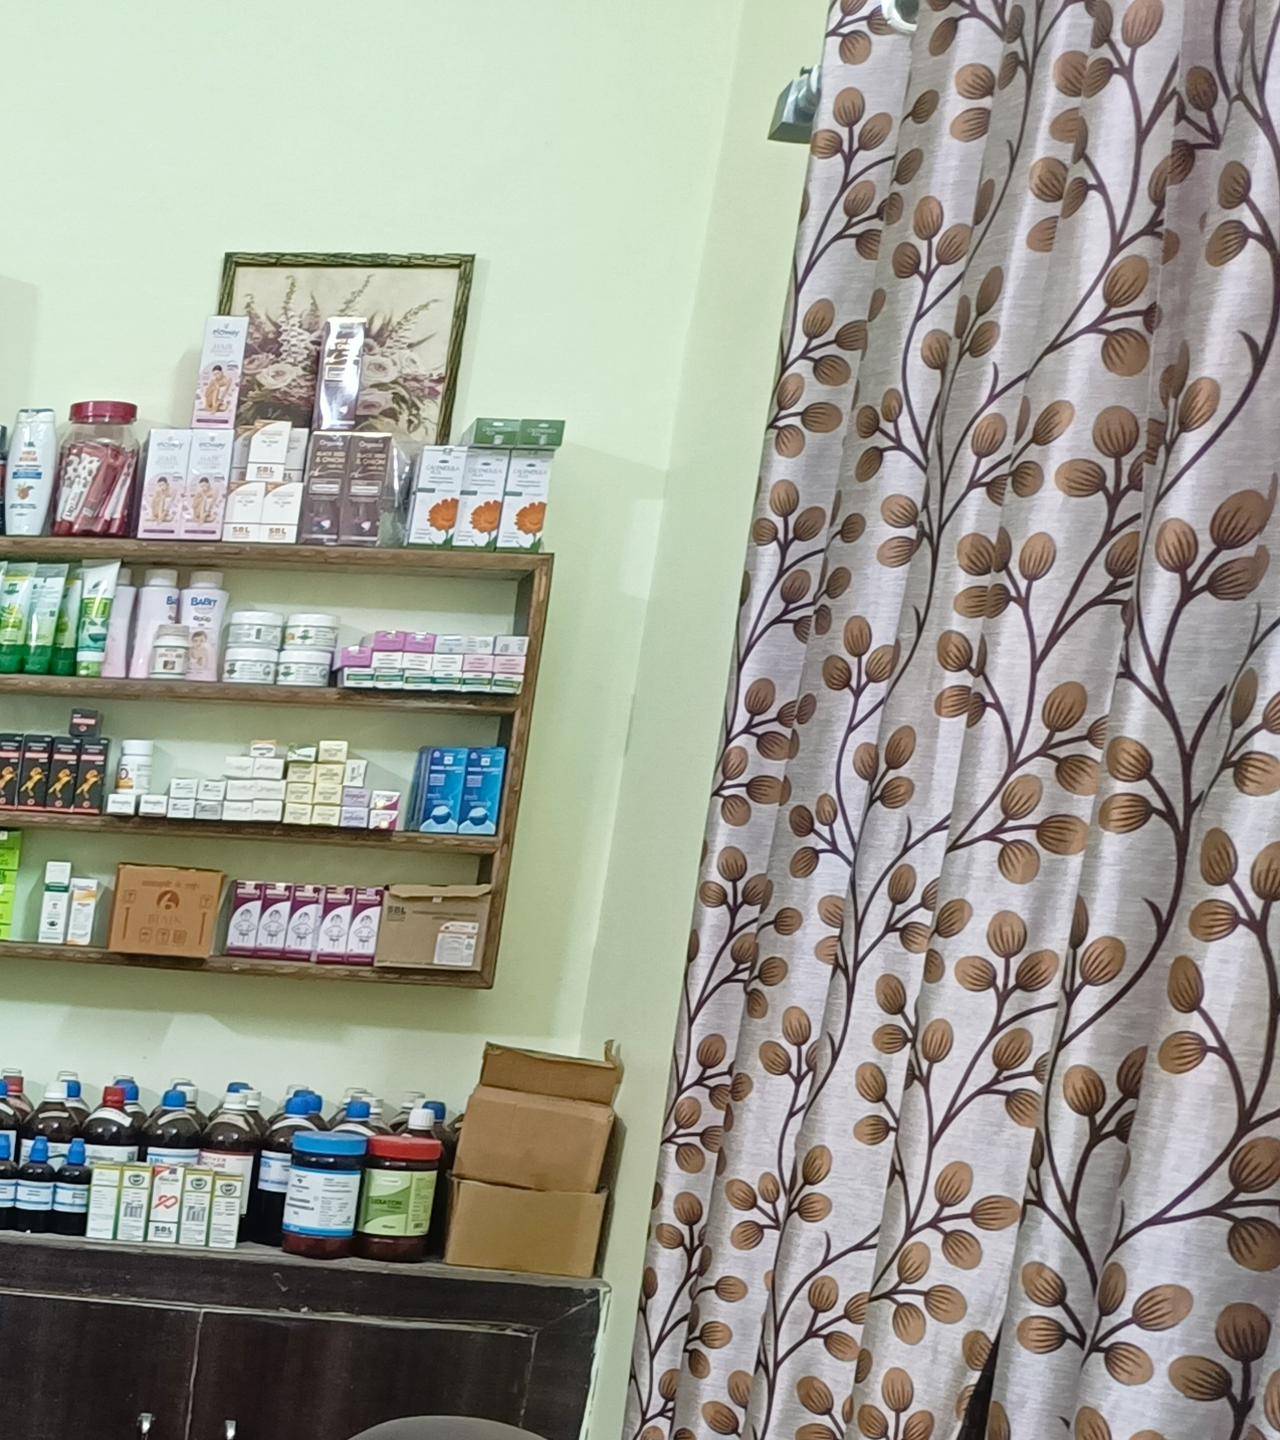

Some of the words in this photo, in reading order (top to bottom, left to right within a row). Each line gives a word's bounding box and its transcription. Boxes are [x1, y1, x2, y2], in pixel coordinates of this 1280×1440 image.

[232, 526, 250, 534] SBL
[387, 906, 406, 914] SBL
[154, 1225, 173, 1234] SBL
